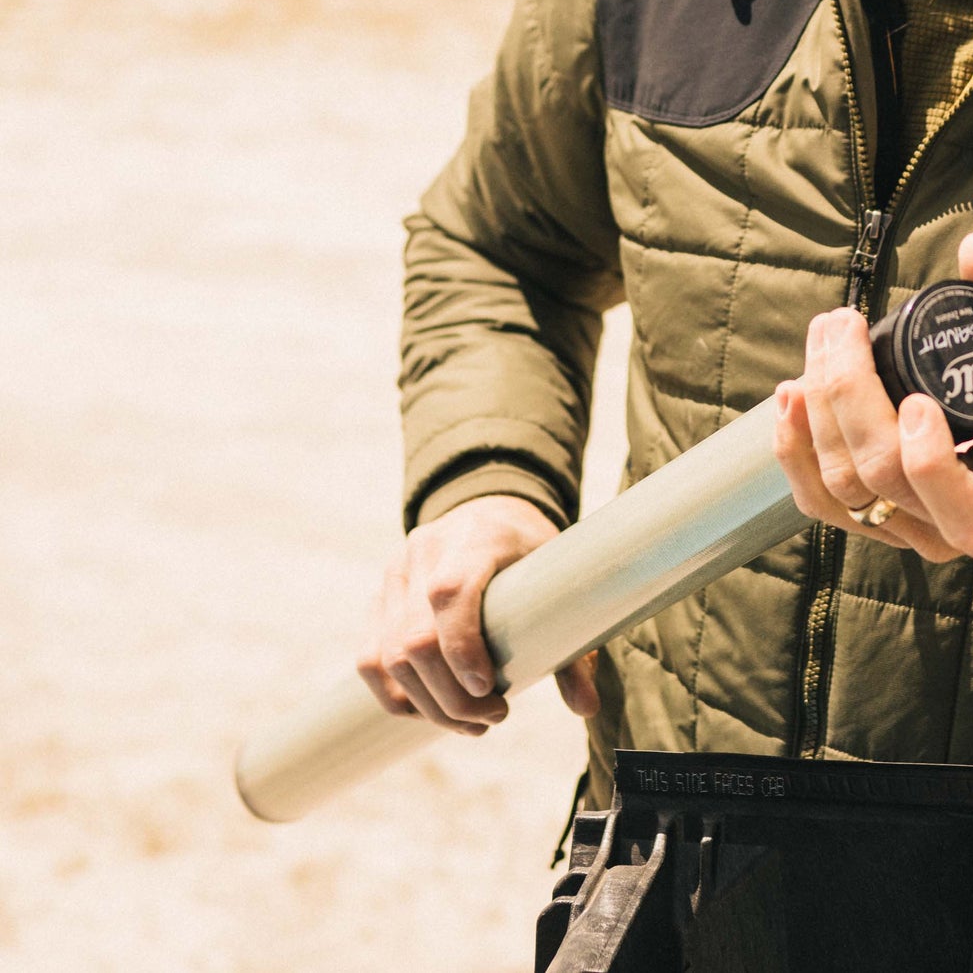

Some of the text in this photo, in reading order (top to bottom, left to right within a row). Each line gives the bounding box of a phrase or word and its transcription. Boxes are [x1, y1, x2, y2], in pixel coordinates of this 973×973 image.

[637, 769, 669, 792] THIS
[675, 772, 707, 793] SIDE
[713, 772, 754, 796] FACES
